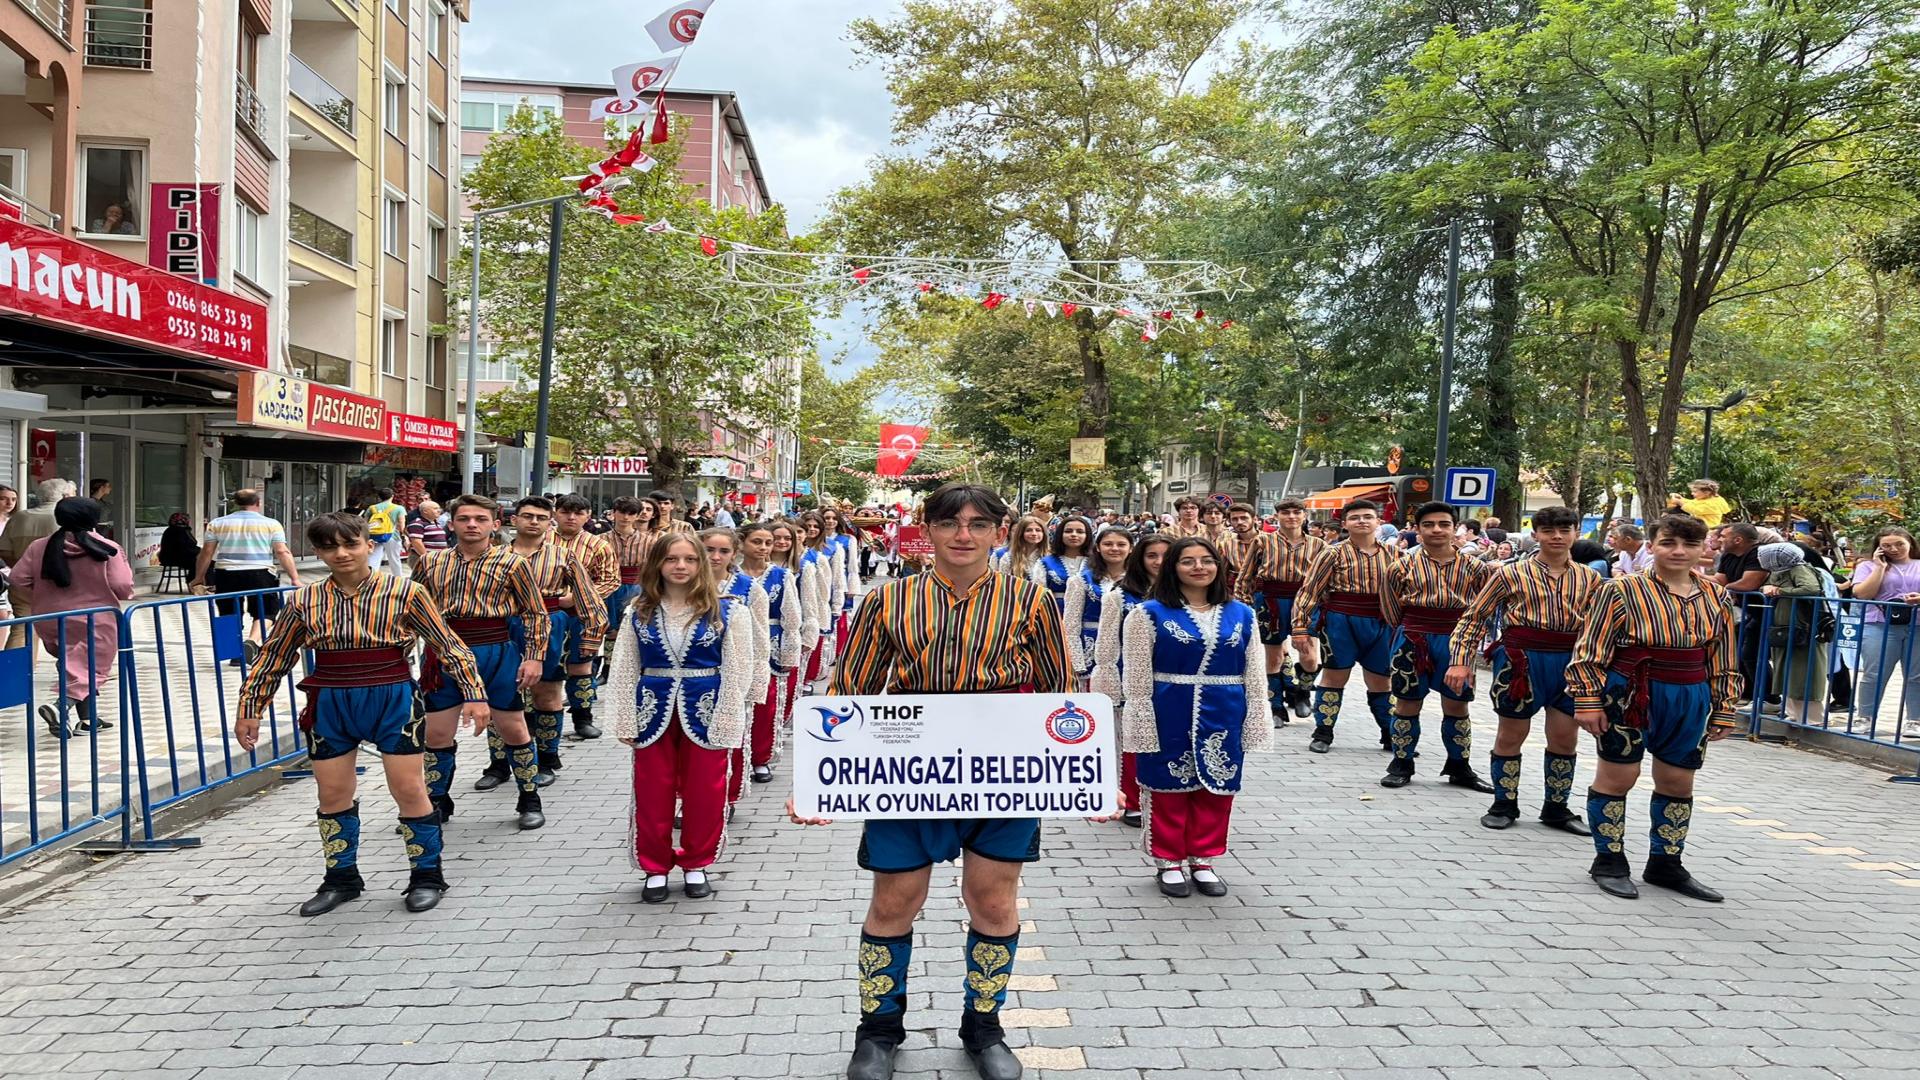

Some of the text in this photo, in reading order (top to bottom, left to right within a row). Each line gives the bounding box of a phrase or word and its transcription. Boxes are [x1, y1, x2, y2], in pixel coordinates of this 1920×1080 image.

[167, 289, 253, 331] 0266 865 33 93
[168, 315, 252, 353] 0535 528 24 91
[278, 377, 287, 400] 3
[258, 399, 304, 424] KARDEŞLER
[311, 393, 384, 431] pastanesi
[403, 417, 455, 439] ÖMER AYBAK
[1458, 476, 1482, 497] D
[869, 705, 924, 720] THOF
[818, 747, 1103, 786] ORHANGAZİ BELEDİYESİ
[817, 787, 1103, 813] HALK OYUNLARI TOPLULUĞU
